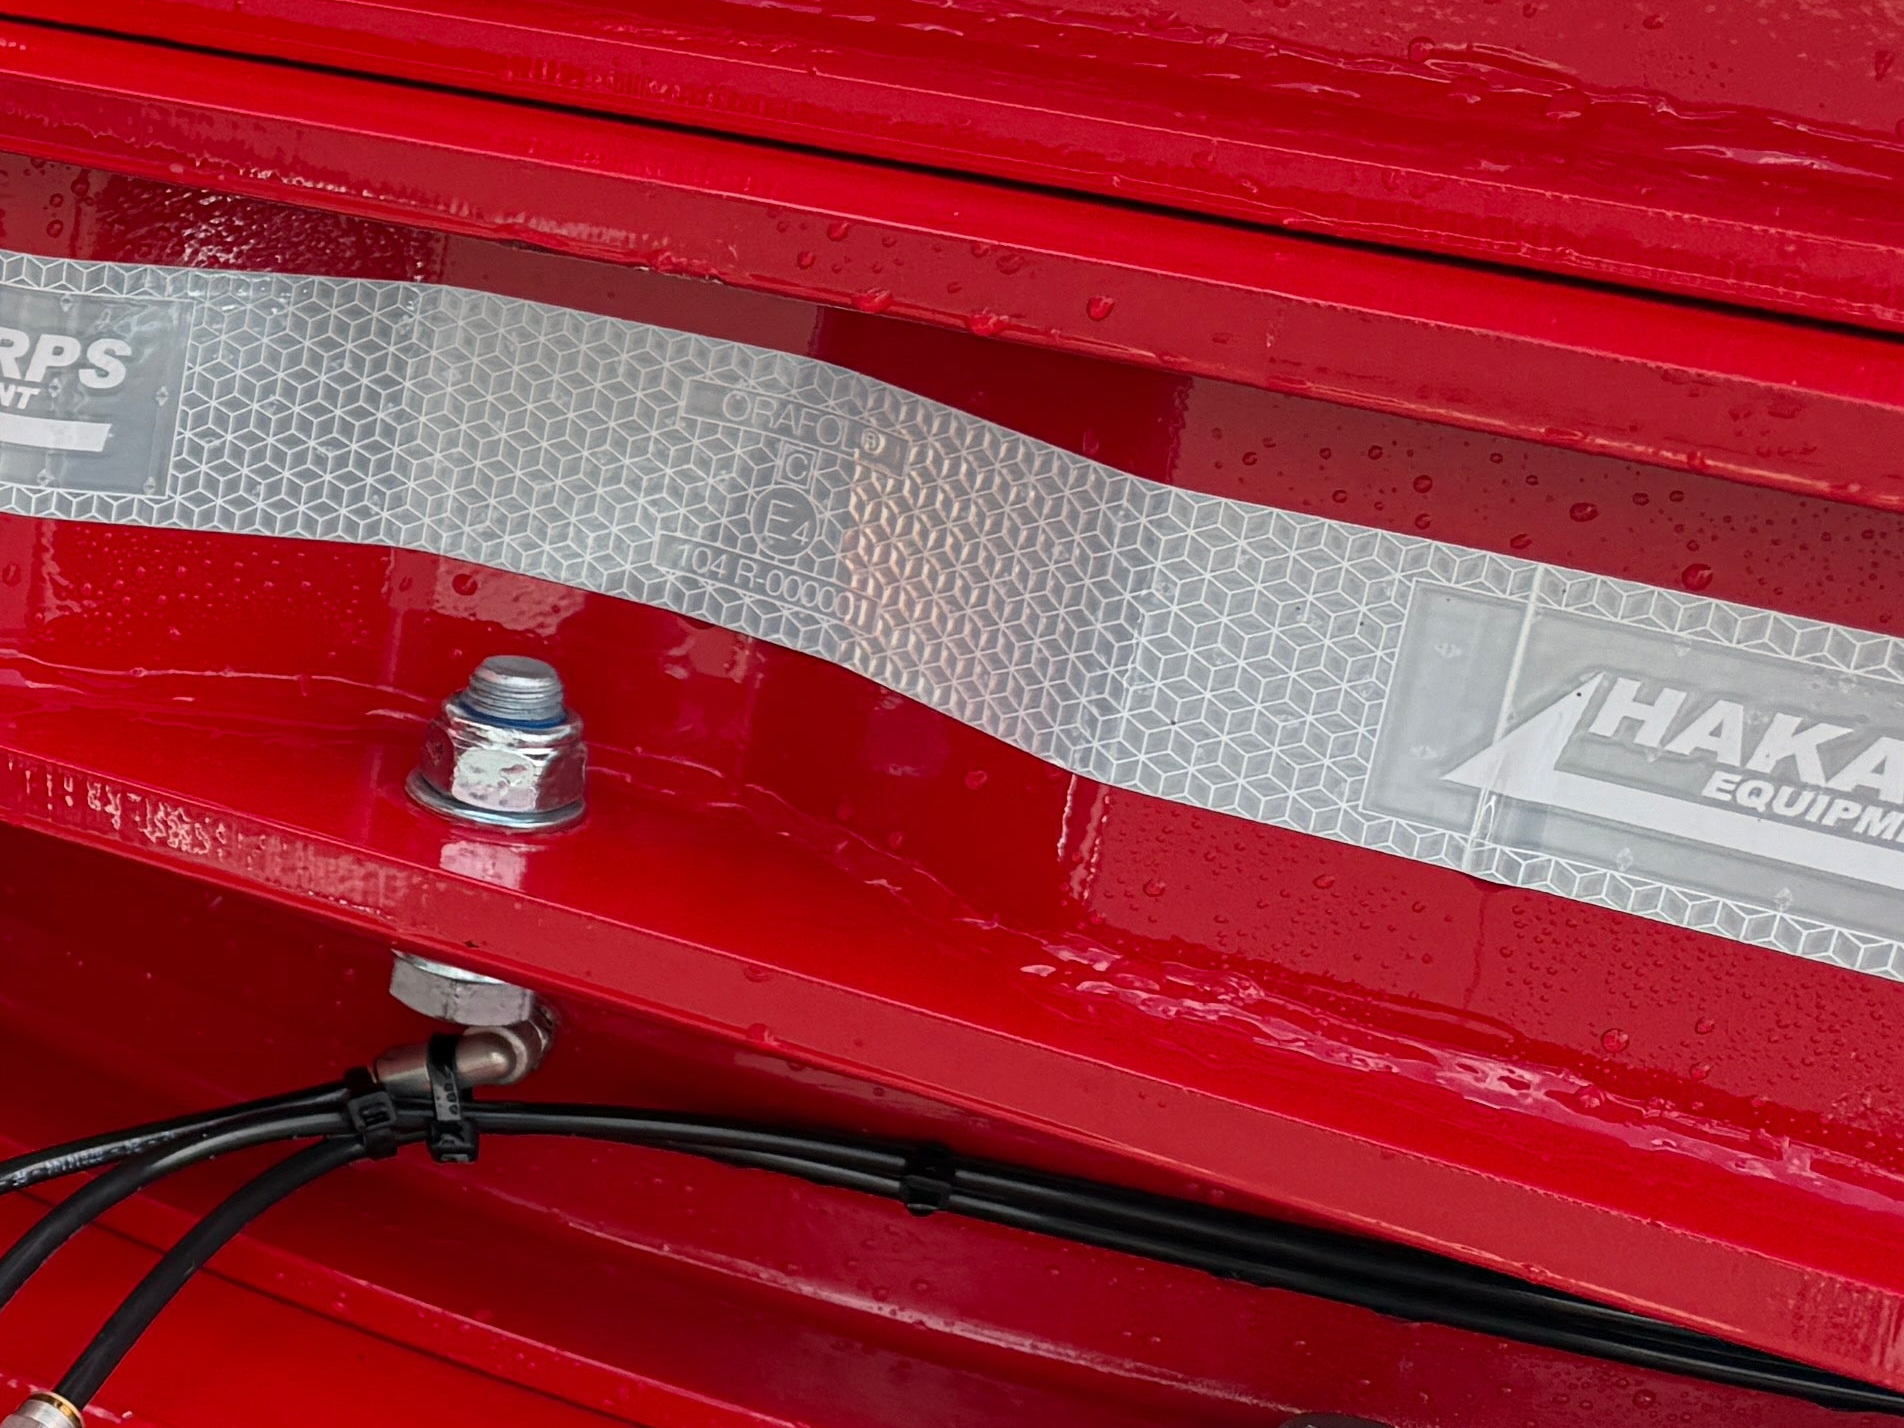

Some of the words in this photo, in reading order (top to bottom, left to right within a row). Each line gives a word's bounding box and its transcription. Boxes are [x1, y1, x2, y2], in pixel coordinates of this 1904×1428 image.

[785, 452, 809, 480] C
[677, 543, 728, 578] 104
[734, 558, 870, 627] R-000001
[1700, 770, 1904, 844] EQUIPM
